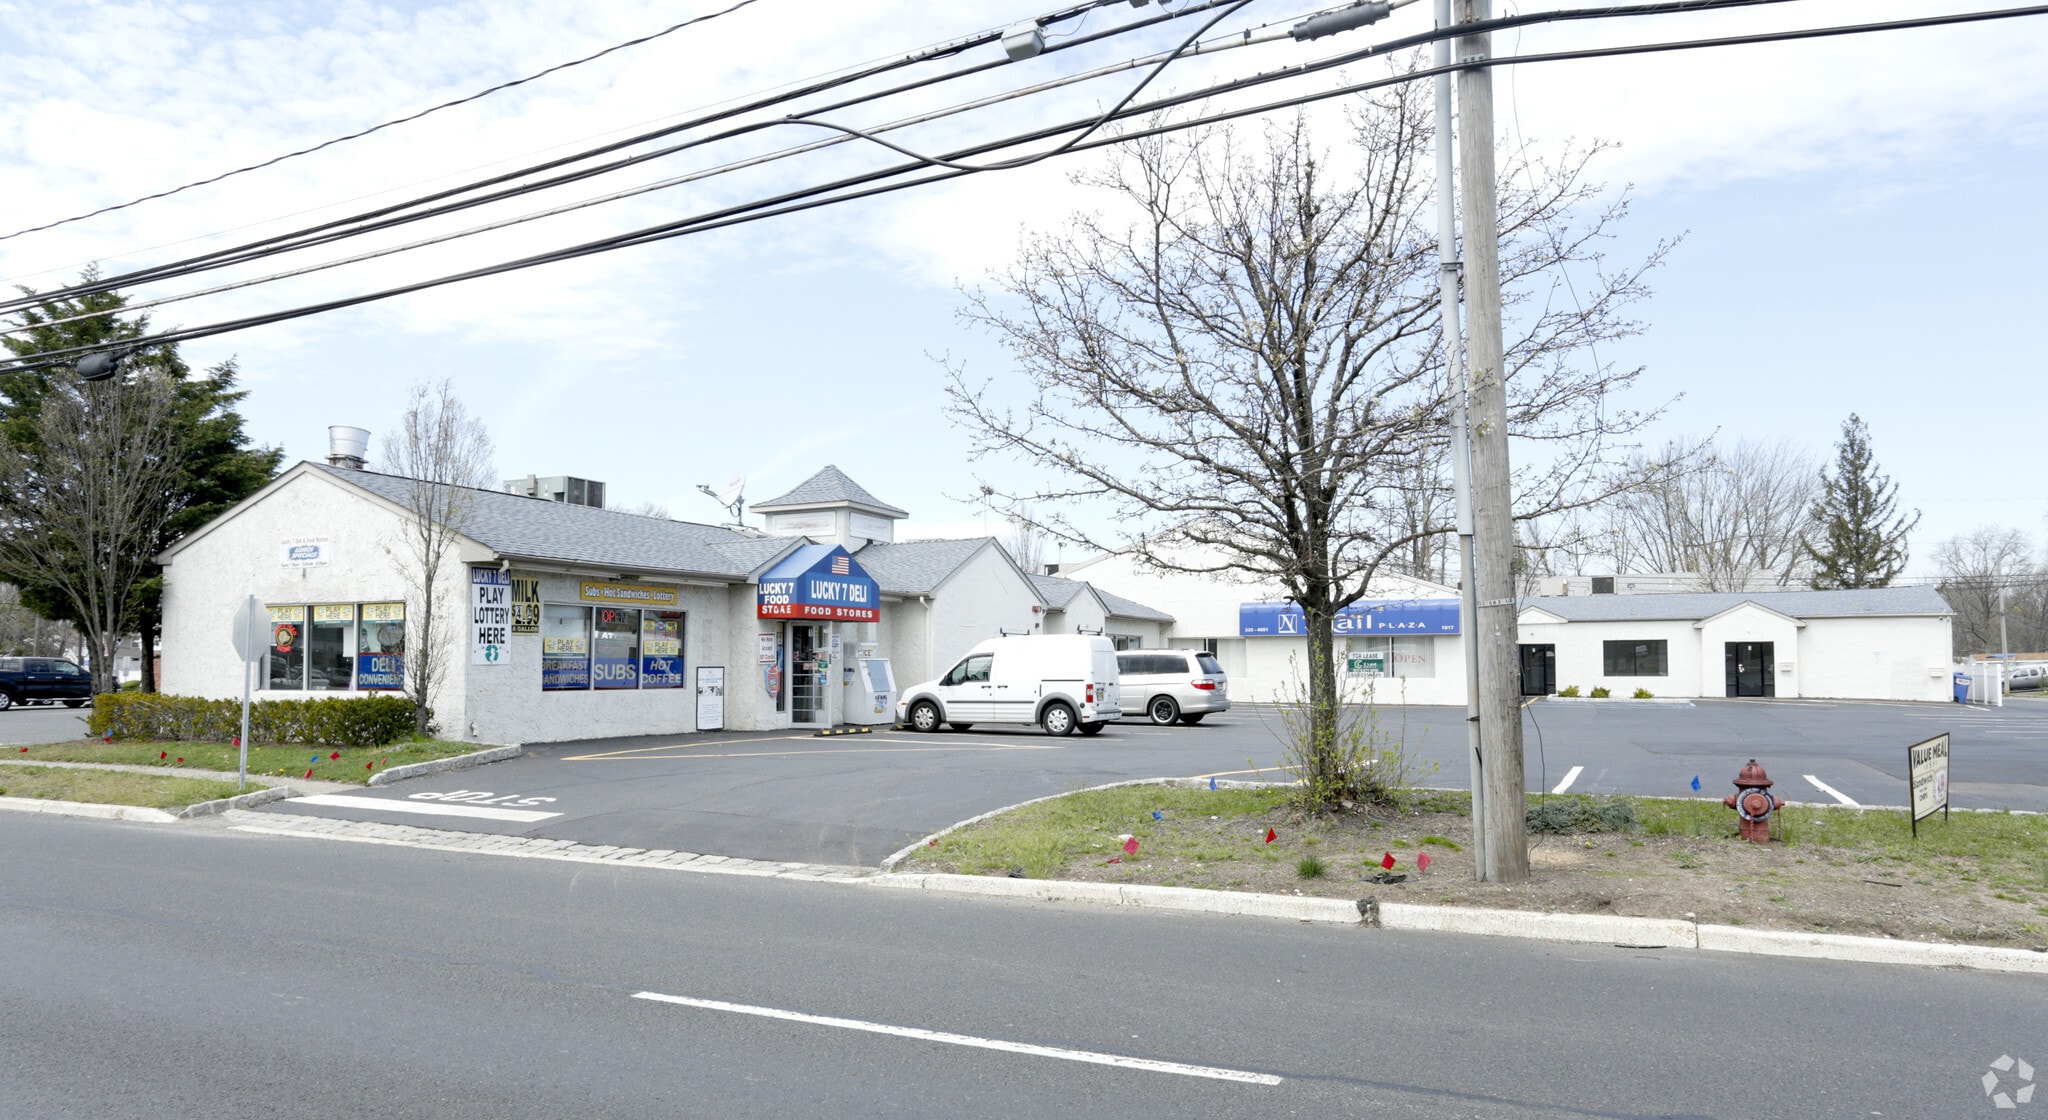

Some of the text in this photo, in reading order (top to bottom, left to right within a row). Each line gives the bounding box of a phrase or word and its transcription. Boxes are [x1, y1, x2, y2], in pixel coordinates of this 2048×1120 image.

[472, 568, 492, 583] LUCKY
[480, 587, 504, 604] PLAY
[511, 579, 540, 602] MILK
[585, 586, 675, 603] Subs Hot Sandwiches Lottery
[759, 582, 794, 594] LUCKY 7
[811, 580, 867, 602] LUCKY 7 DELI
[764, 595, 789, 604] FOOD
[474, 607, 510, 624] LOTTERY
[804, 606, 873, 618] FOOD STORES
[479, 627, 505, 644] HERE
[371, 658, 396, 672] DELI
[542, 660, 588, 671] BREAKFAST
[650, 660, 673, 670] HOT
[1394, 654, 1426, 663] OPEN
[594, 664, 636, 680] SUBS
[642, 673, 682, 684] COFFEE
[1912, 748, 1932, 770] VALUE
[1932, 738, 1948, 760] MEAL
